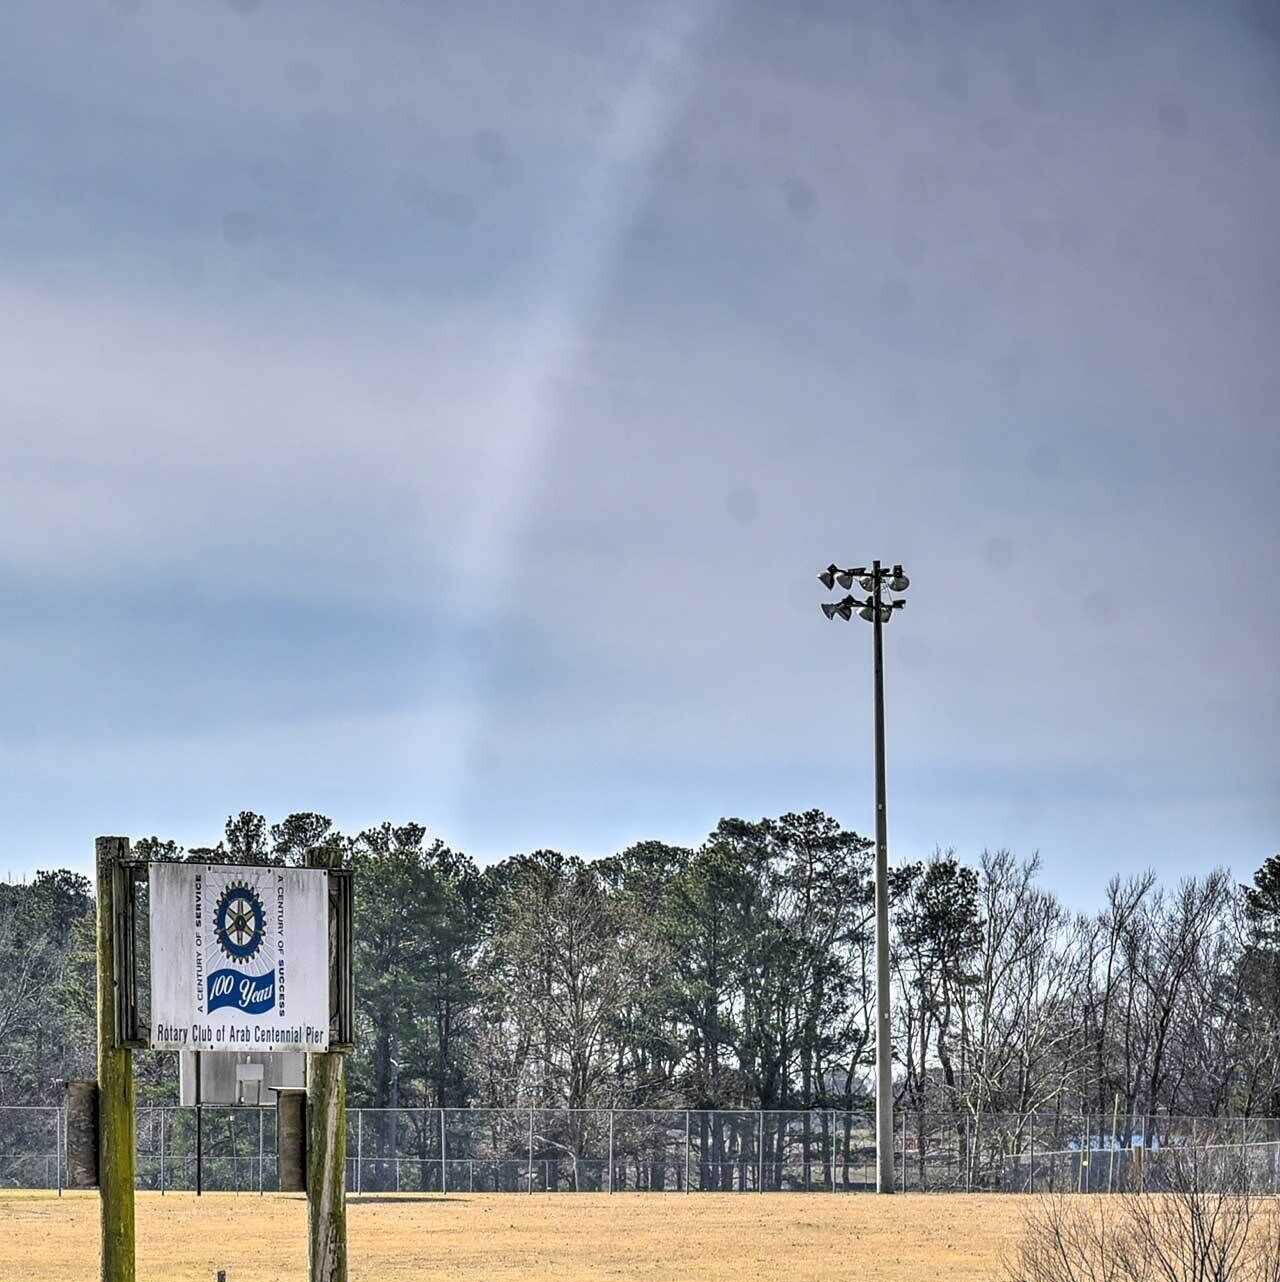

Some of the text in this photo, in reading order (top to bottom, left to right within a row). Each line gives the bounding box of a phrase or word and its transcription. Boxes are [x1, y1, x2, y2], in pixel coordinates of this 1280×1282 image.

[277, 875, 284, 883] A
[195, 932, 202, 947] OF
[277, 940, 285, 955] OF
[195, 951, 204, 1001] CENTURY
[209, 974, 274, 1008] 100 Years
[278, 959, 286, 1018] SUCCESS
[197, 1005, 204, 1013] A
[157, 1023, 324, 1044] Rotary Club of Arab Centennial Pier
